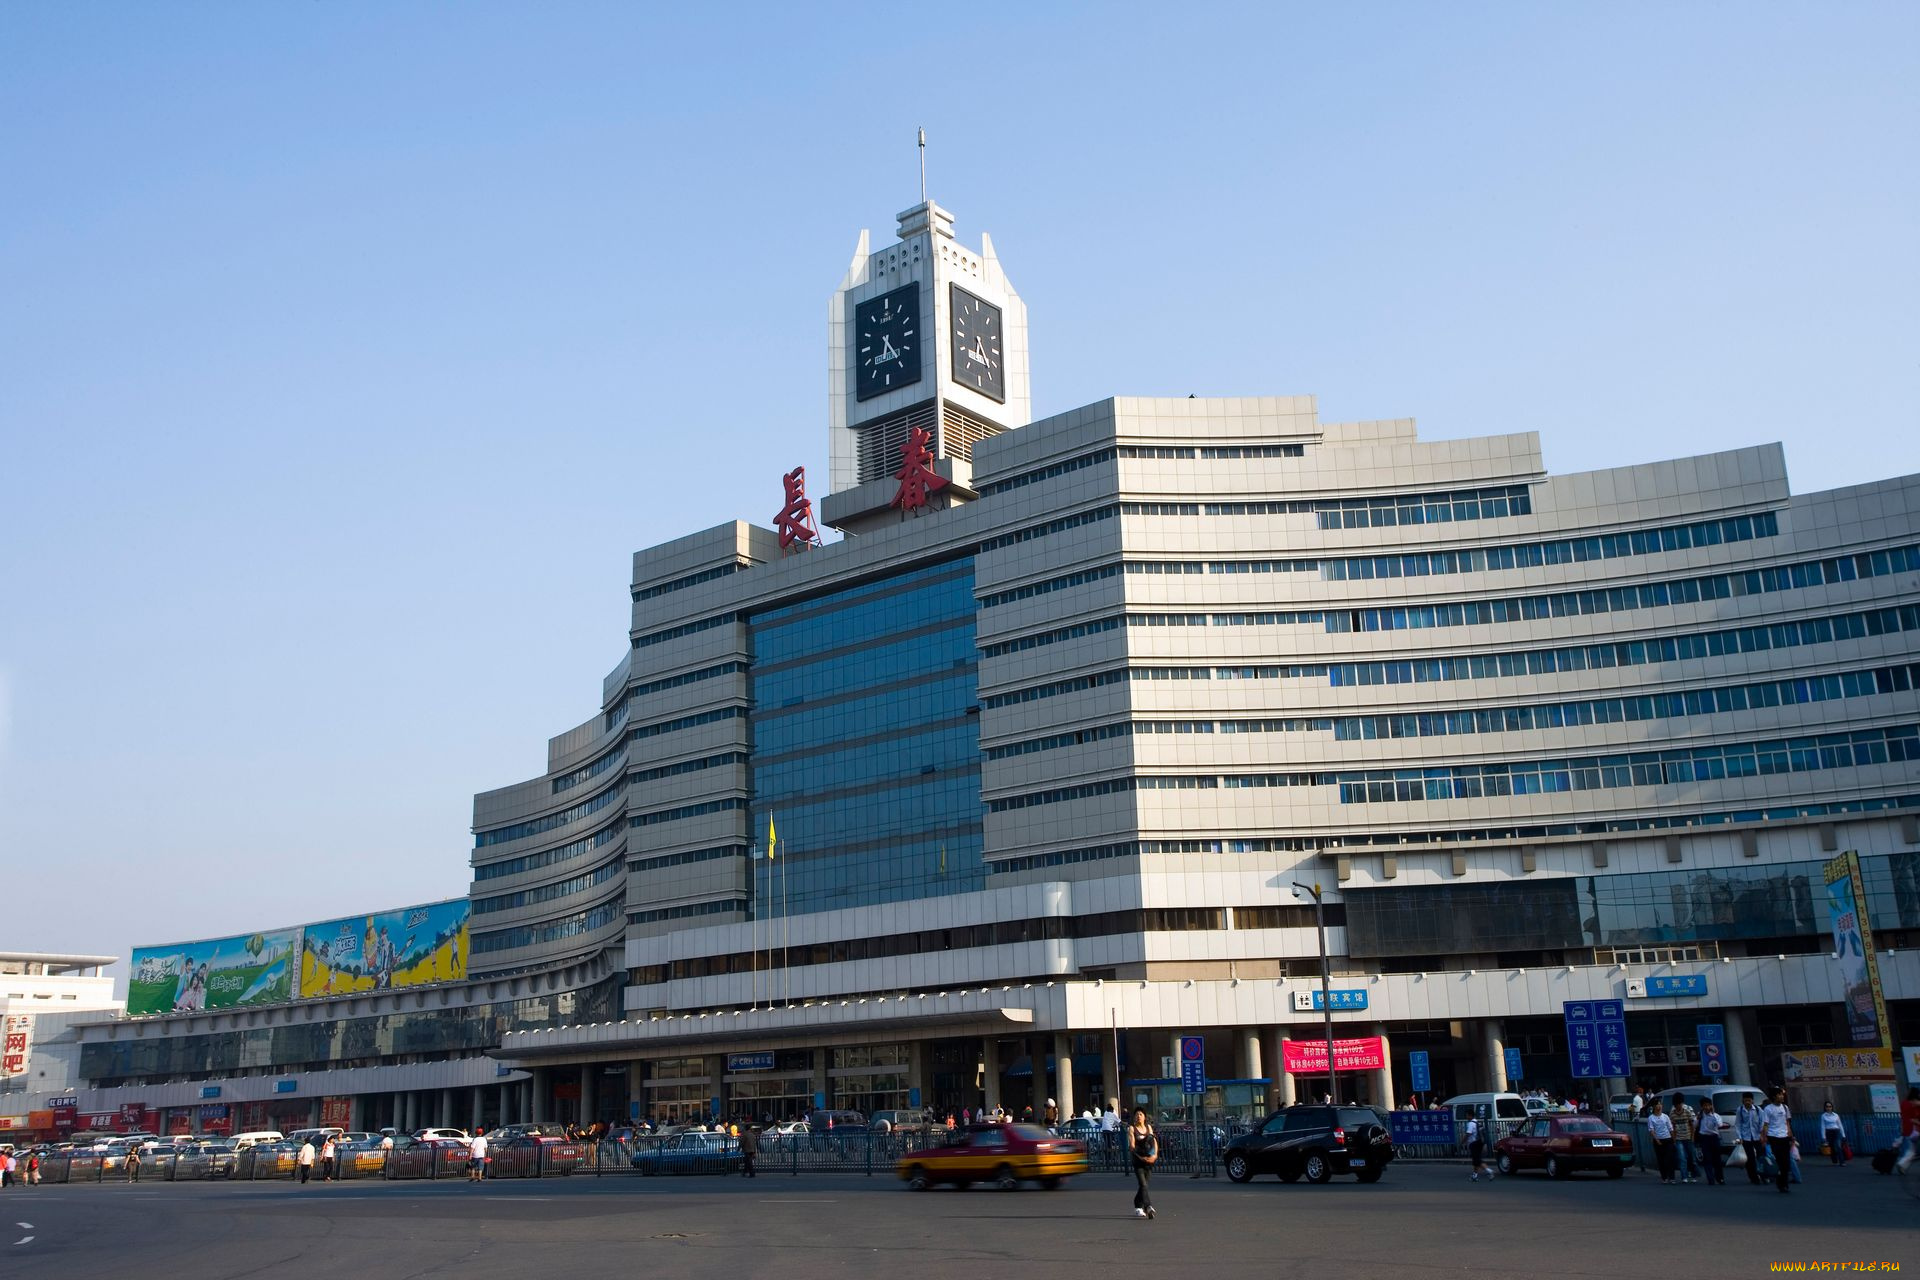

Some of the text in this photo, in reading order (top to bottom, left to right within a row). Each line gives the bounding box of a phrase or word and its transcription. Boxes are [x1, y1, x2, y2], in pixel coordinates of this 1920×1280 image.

[739, 1057, 753, 1065] CRH
[1576, 1025, 1591, 1062] 出租车
[1604, 1024, 1621, 1062] 社会车
